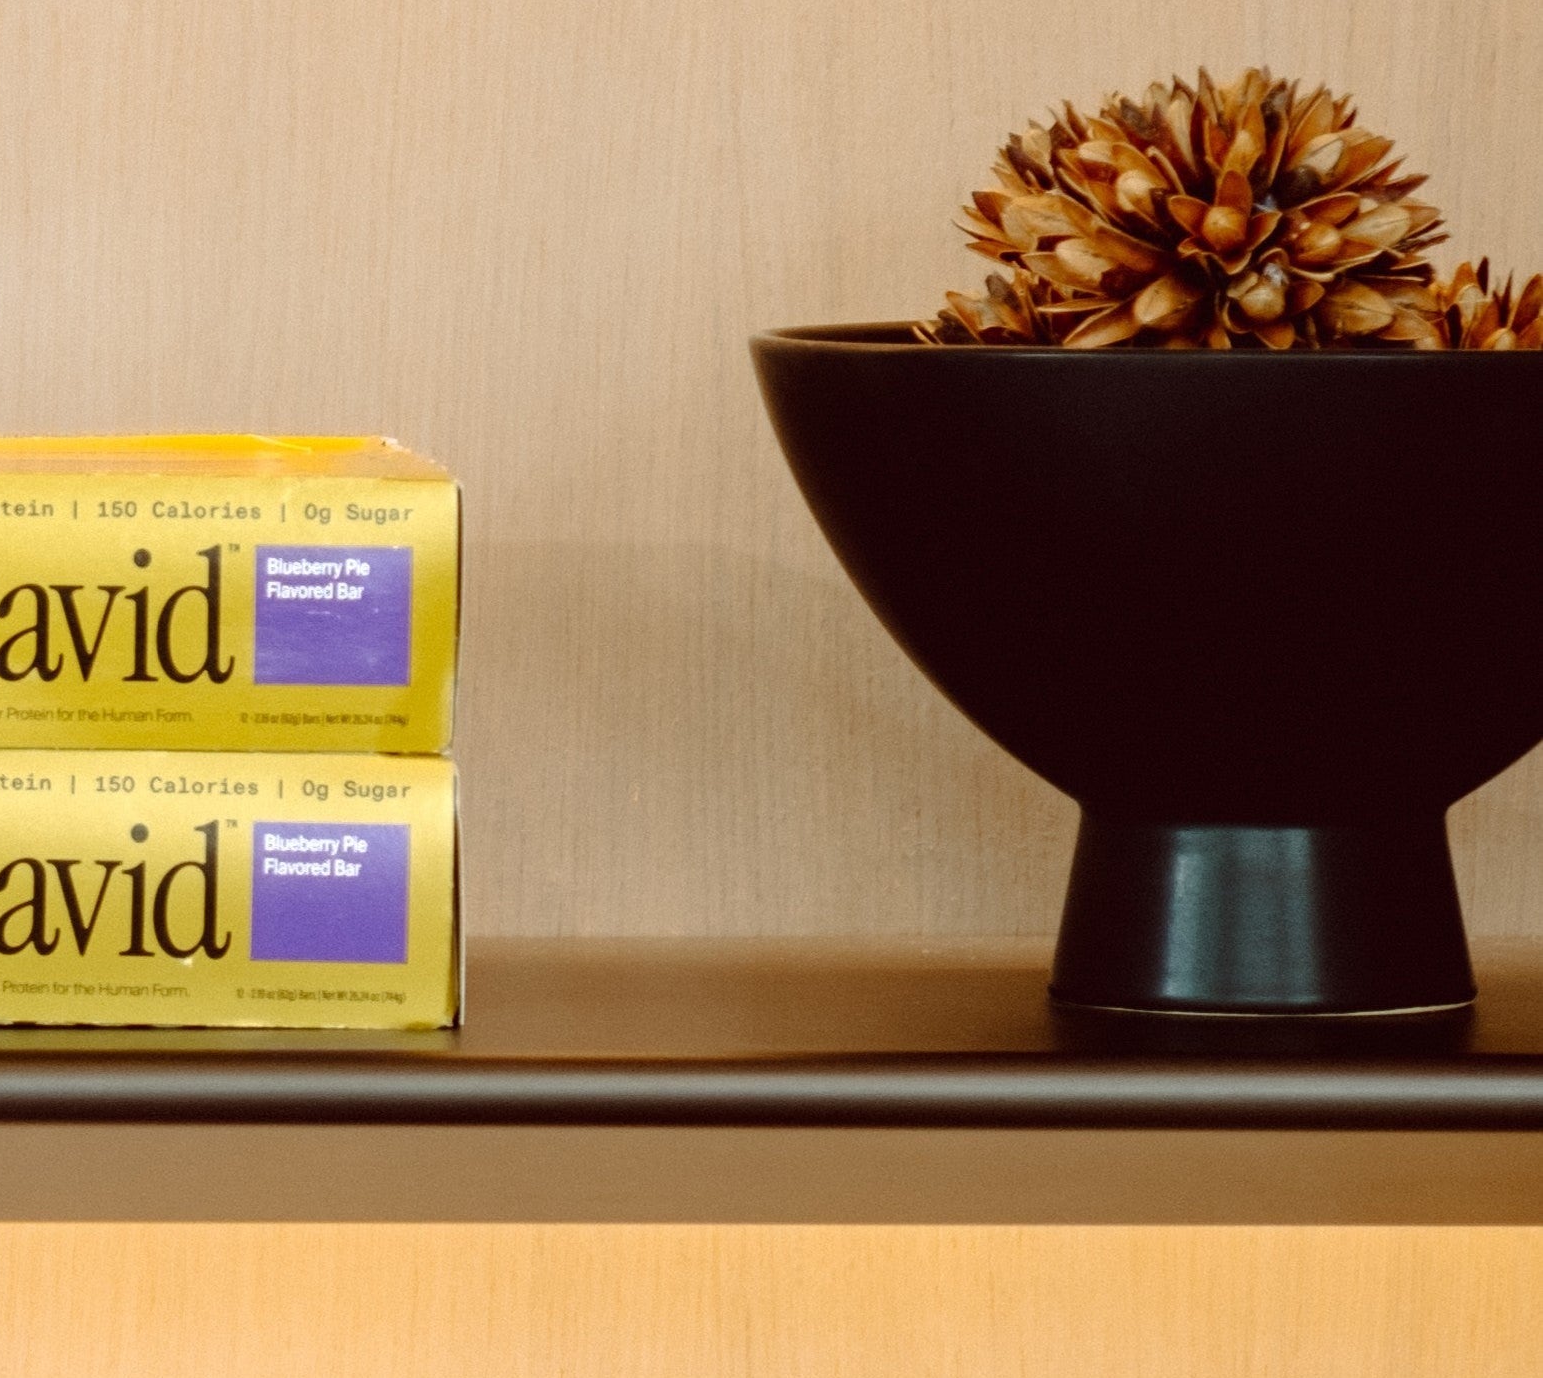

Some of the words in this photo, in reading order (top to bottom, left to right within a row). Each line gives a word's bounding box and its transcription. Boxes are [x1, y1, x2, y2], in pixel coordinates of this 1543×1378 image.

[98, 500, 137, 518] 150
[151, 500, 261, 520] Calories
[303, 502, 331, 525] 0g
[345, 502, 413, 526] Sugar
[266, 557, 342, 579] Blueberry
[345, 558, 370, 576] Pie
[265, 580, 334, 600] Flavored
[336, 582, 364, 600] Bar
[6, 706, 54, 721] Protein
[56, 707, 74, 721] for
[77, 708, 100, 721] the
[102, 708, 153, 722] Human
[95, 774, 135, 793] 150
[149, 775, 259, 796] Calories
[301, 779, 329, 801] 0g
[343, 779, 411, 803] Sugar
[263, 832, 340, 855] Blueberry
[342, 834, 368, 852] Pie
[262, 856, 331, 876] Flavored
[333, 858, 361, 876] Bar
[2, 979, 50, 995] Protein
[52, 981, 70, 995] for
[73, 982, 96, 996] the
[98, 982, 149, 997] Human
